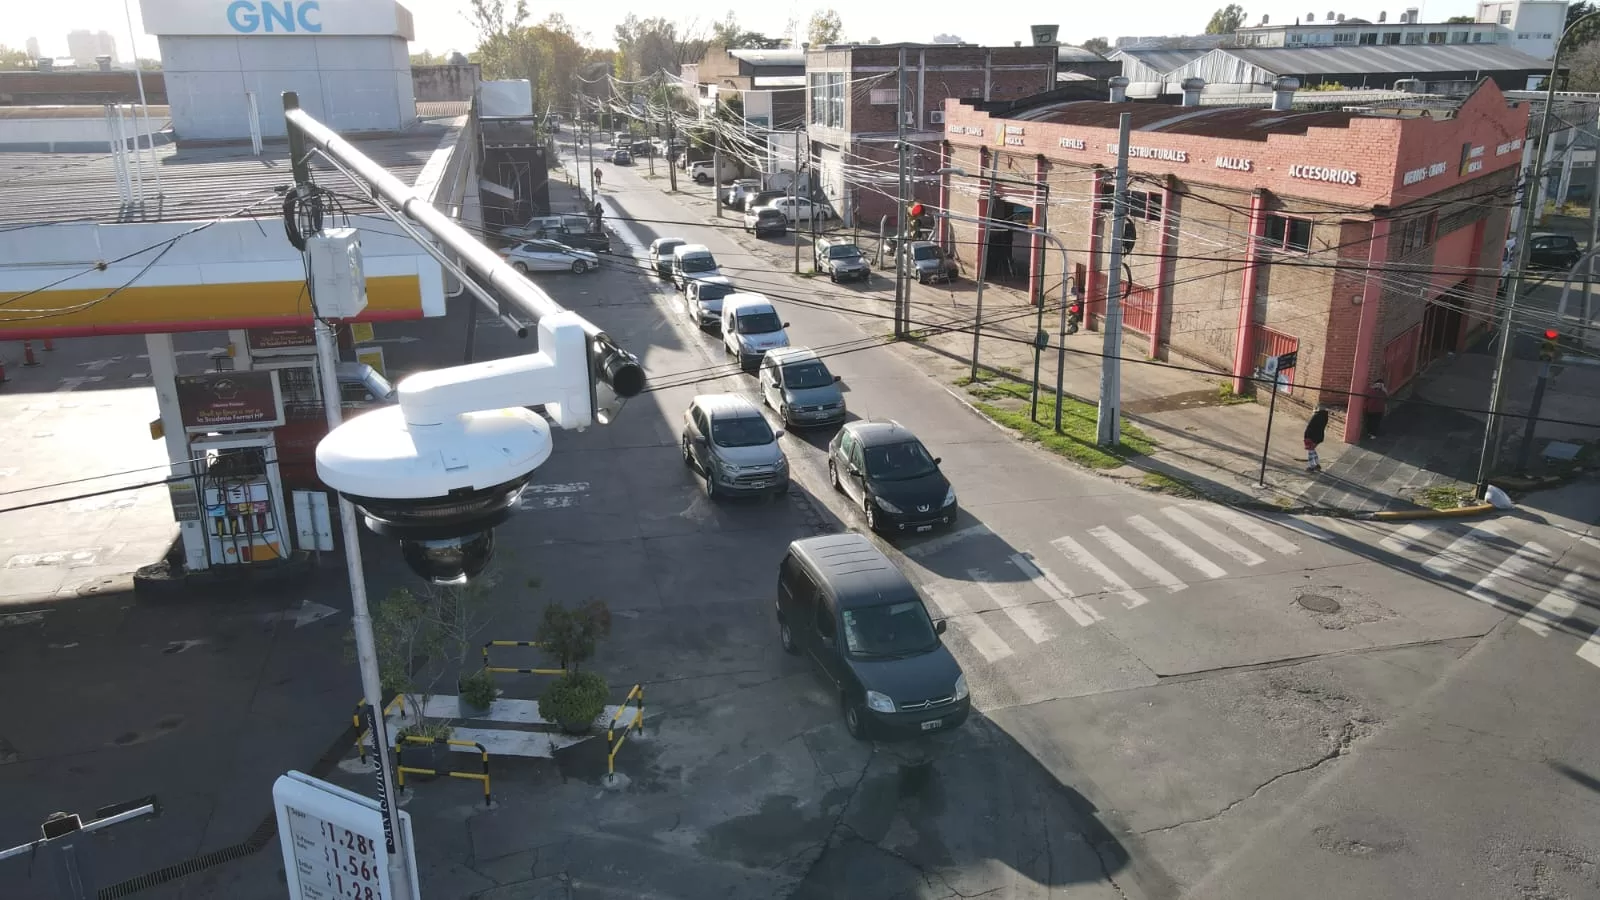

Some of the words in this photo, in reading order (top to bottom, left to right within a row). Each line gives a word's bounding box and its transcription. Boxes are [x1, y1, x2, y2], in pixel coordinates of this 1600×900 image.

[227, 0, 322, 33] GNC
[1059, 137, 1085, 150] PERFILES
[1128, 146, 1187, 162] ESTRUCTURALES
[1215, 156, 1252, 171] MALLAS
[1288, 164, 1358, 185] ACCESORIOS
